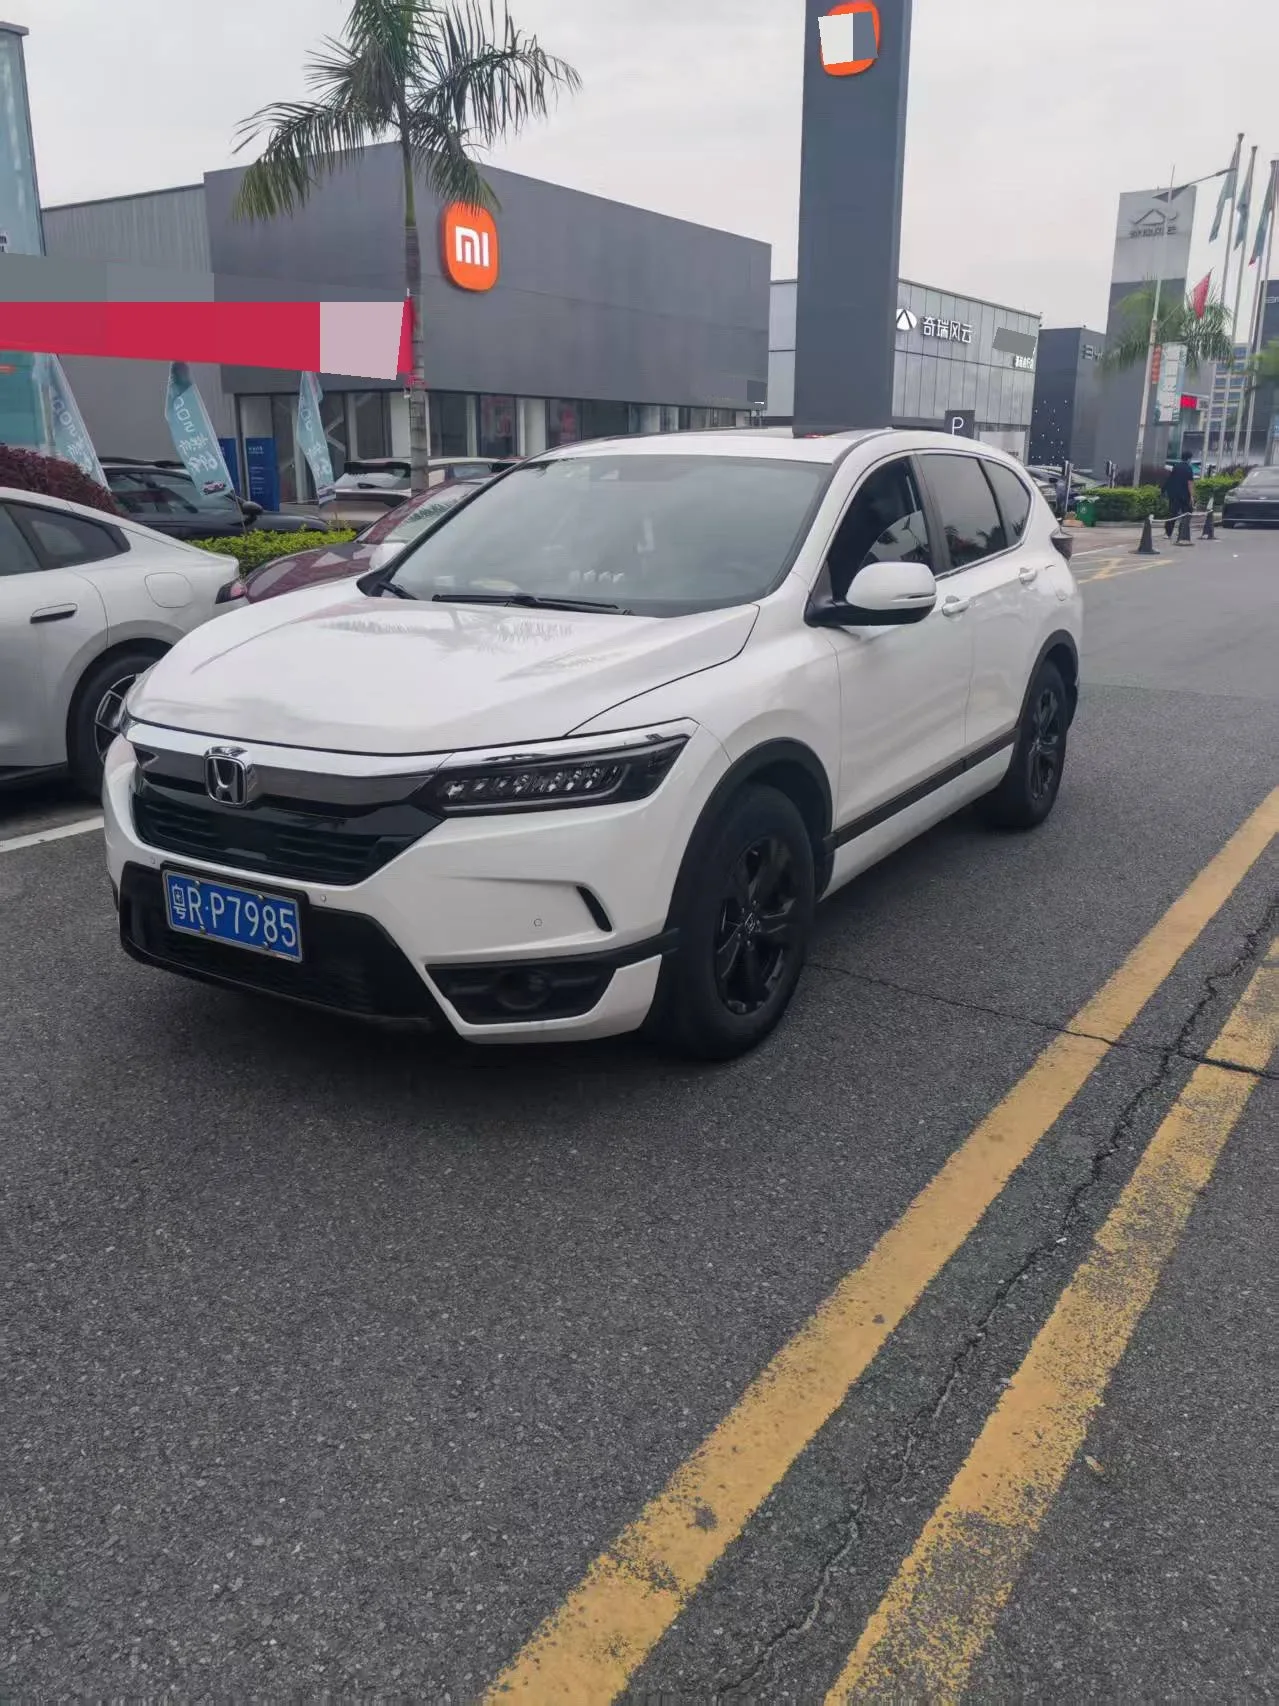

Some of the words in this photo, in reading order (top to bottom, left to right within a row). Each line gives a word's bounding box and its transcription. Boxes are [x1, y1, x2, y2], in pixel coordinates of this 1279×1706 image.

[922, 317, 973, 343] 奇瑞风云
[952, 416, 964, 436] P
